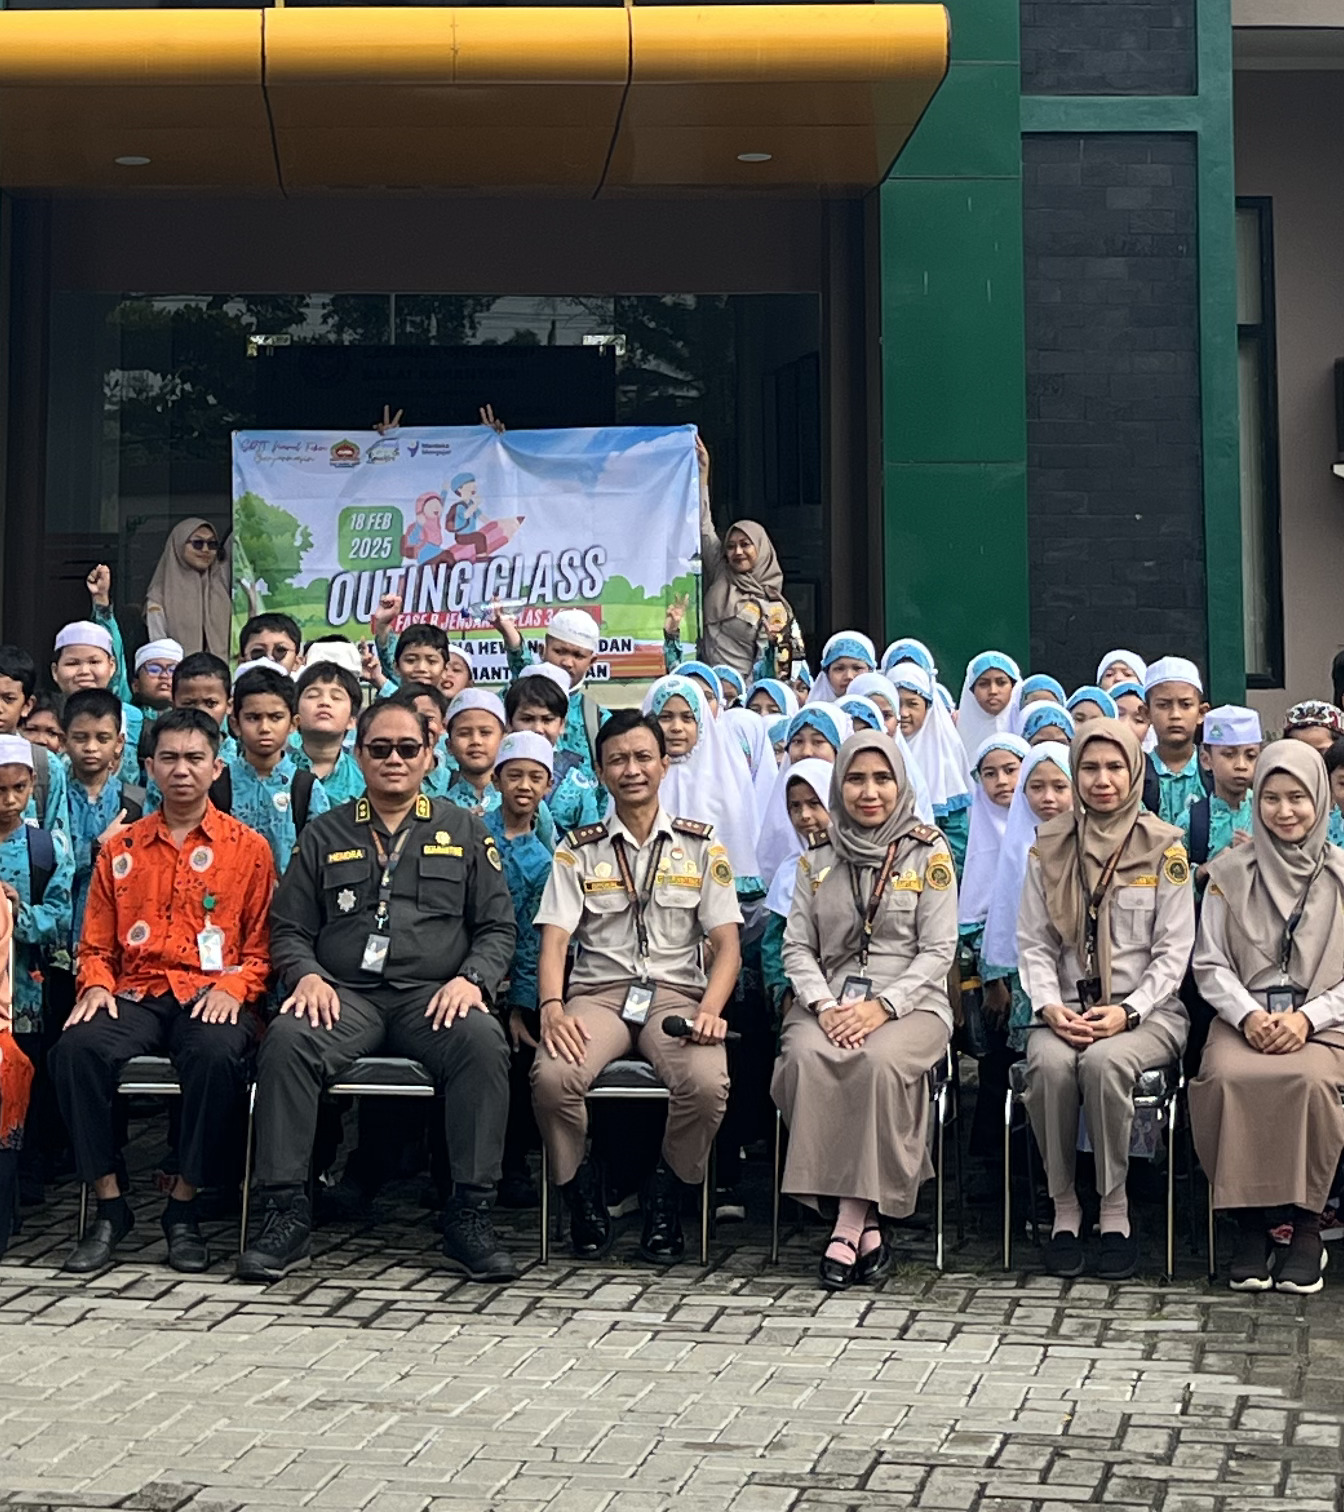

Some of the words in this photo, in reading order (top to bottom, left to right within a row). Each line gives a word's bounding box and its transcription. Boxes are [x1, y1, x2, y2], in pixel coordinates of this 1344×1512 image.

[350, 512, 364, 530] 18
[367, 512, 393, 530] FEB
[348, 537, 394, 559] 2025
[327, 560, 474, 626] OUTING
[482, 545, 606, 605] CLASS
